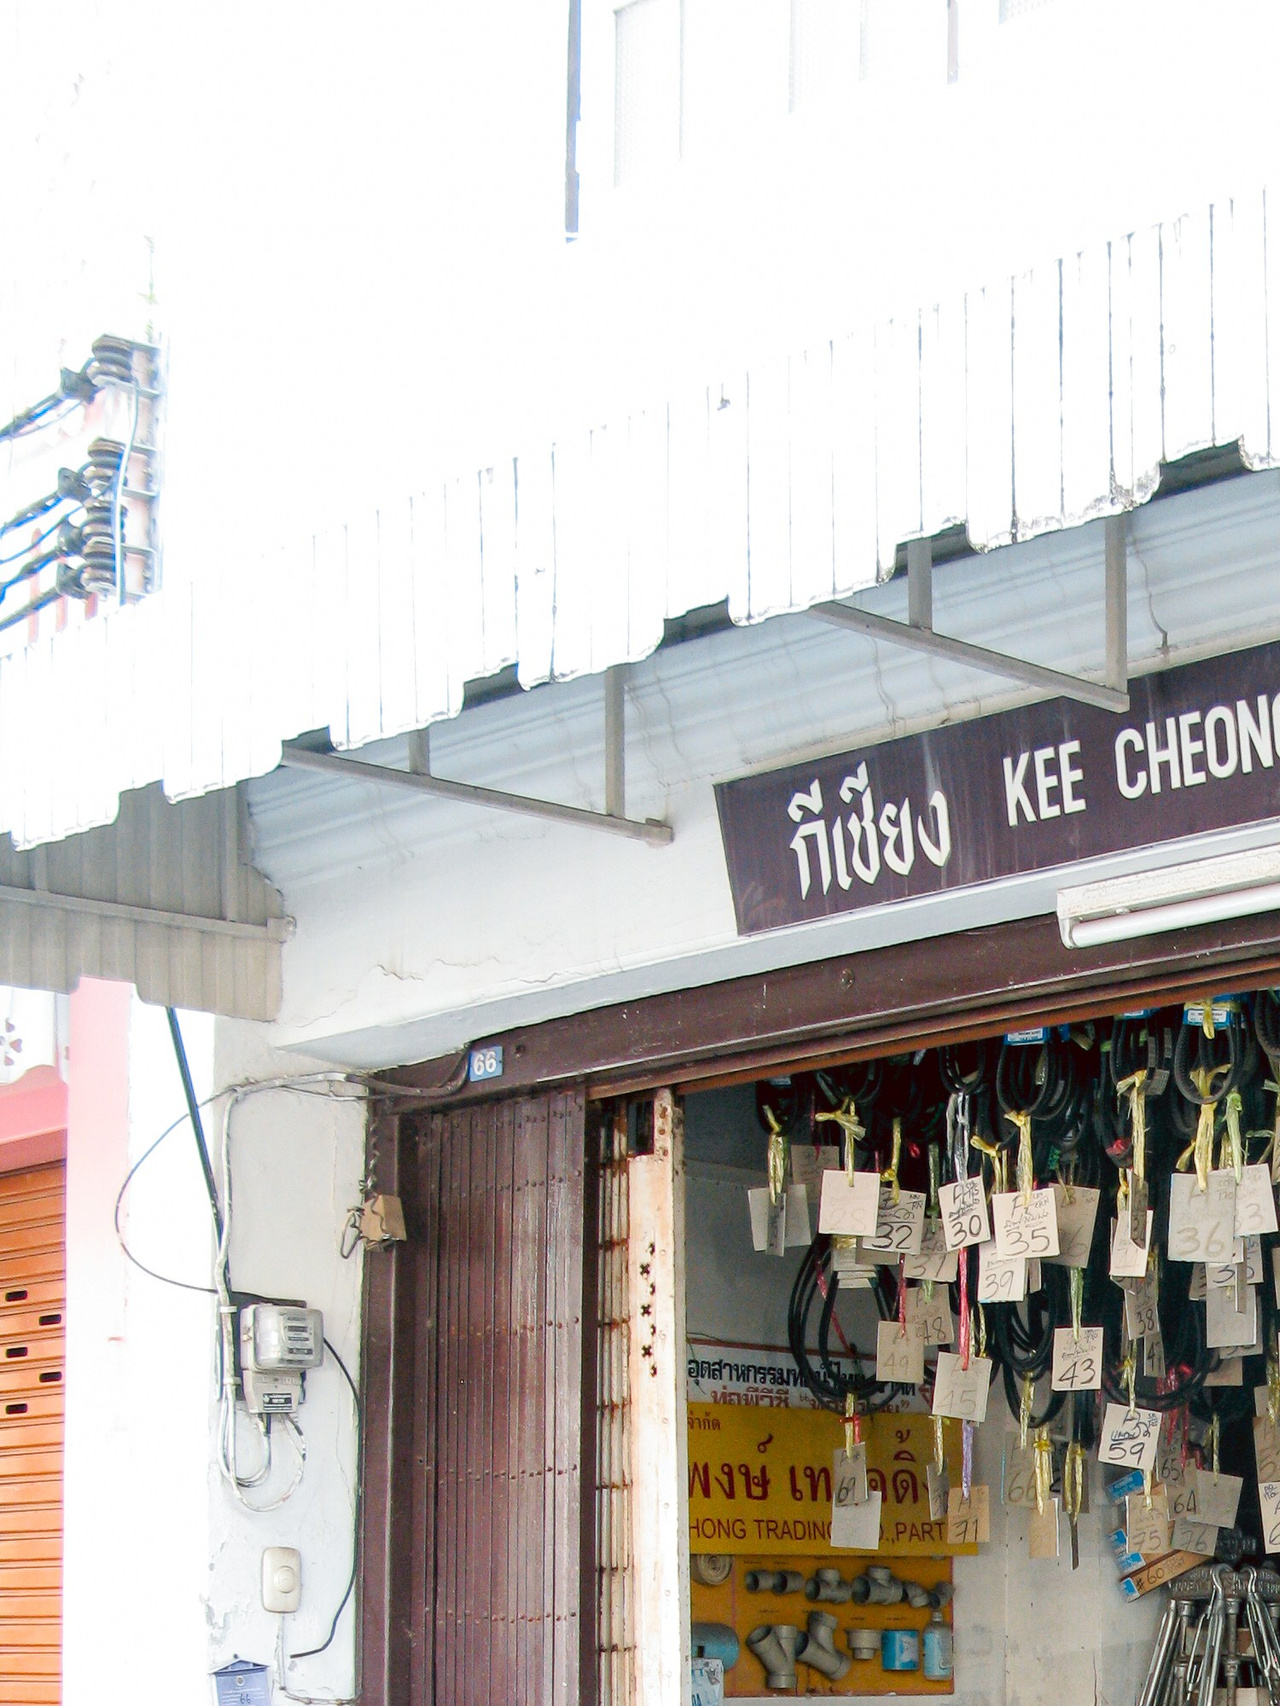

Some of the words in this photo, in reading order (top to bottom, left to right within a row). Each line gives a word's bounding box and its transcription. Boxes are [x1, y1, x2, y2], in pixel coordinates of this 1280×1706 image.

[1002, 741, 1085, 827] KEE
[474, 1051, 496, 1075] 66
[871, 1224, 913, 1250] 32
[951, 1214, 983, 1247] 30
[1004, 1226, 1051, 1256] 35
[1176, 1221, 1224, 1258] 36
[984, 1269, 1014, 1300] 39
[1058, 1358, 1096, 1389] 43
[1107, 1441, 1145, 1467] 59
[953, 1517, 979, 1544] 71
